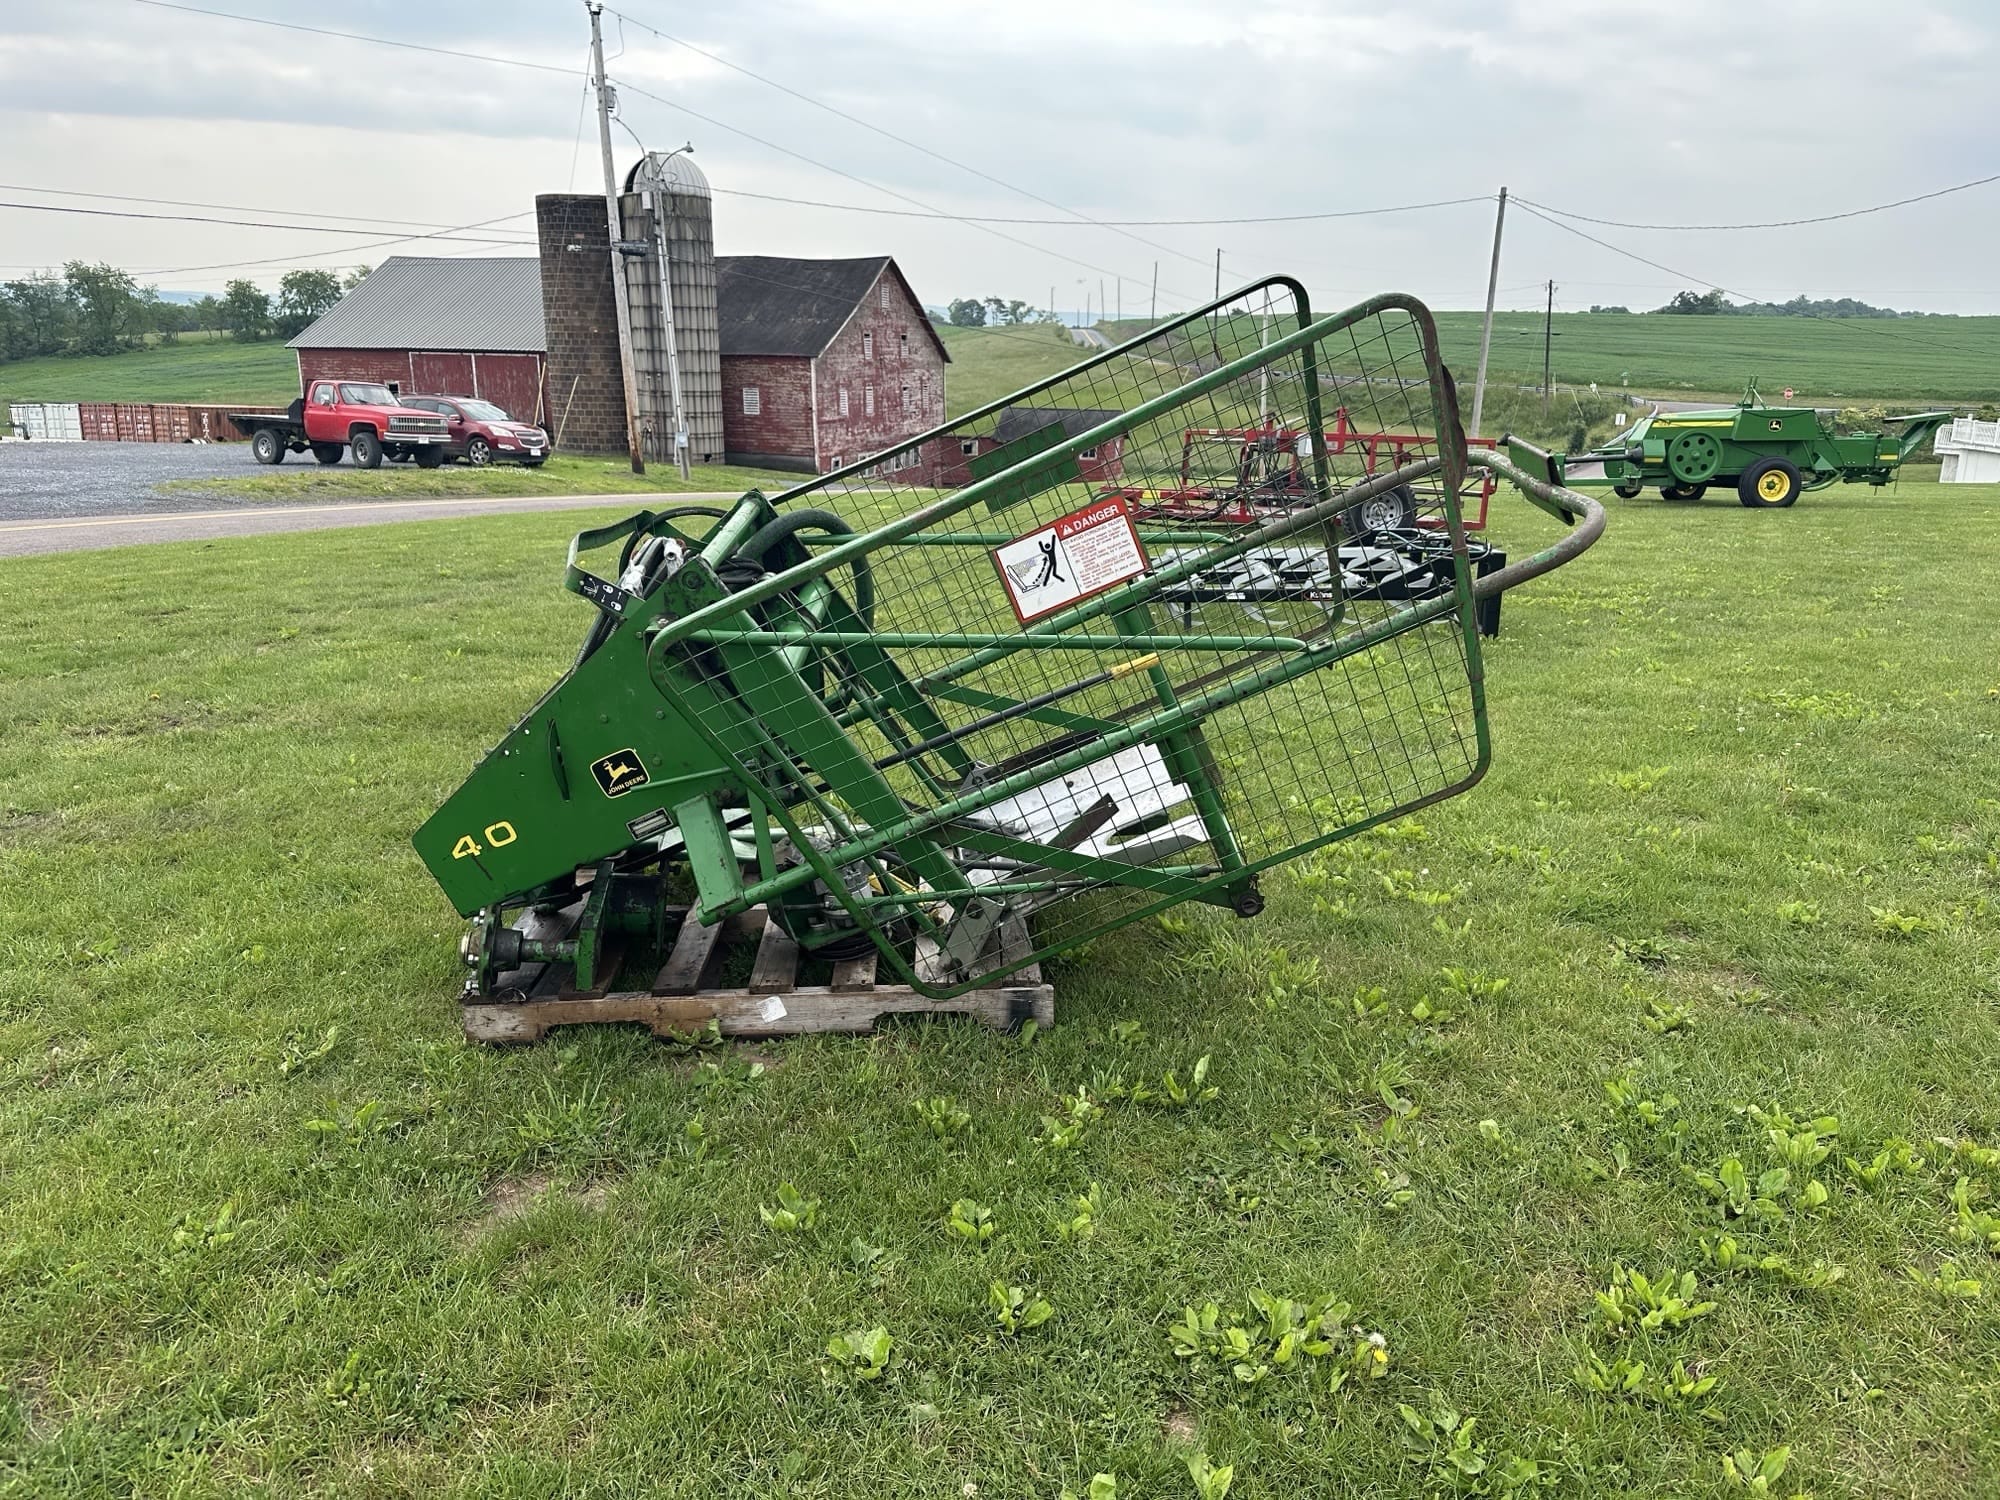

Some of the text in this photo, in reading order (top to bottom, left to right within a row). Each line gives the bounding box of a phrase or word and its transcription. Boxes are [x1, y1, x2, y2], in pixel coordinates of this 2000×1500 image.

[1073, 504, 1119, 530] DANGER
[608, 775, 645, 794] JOHN DEERE
